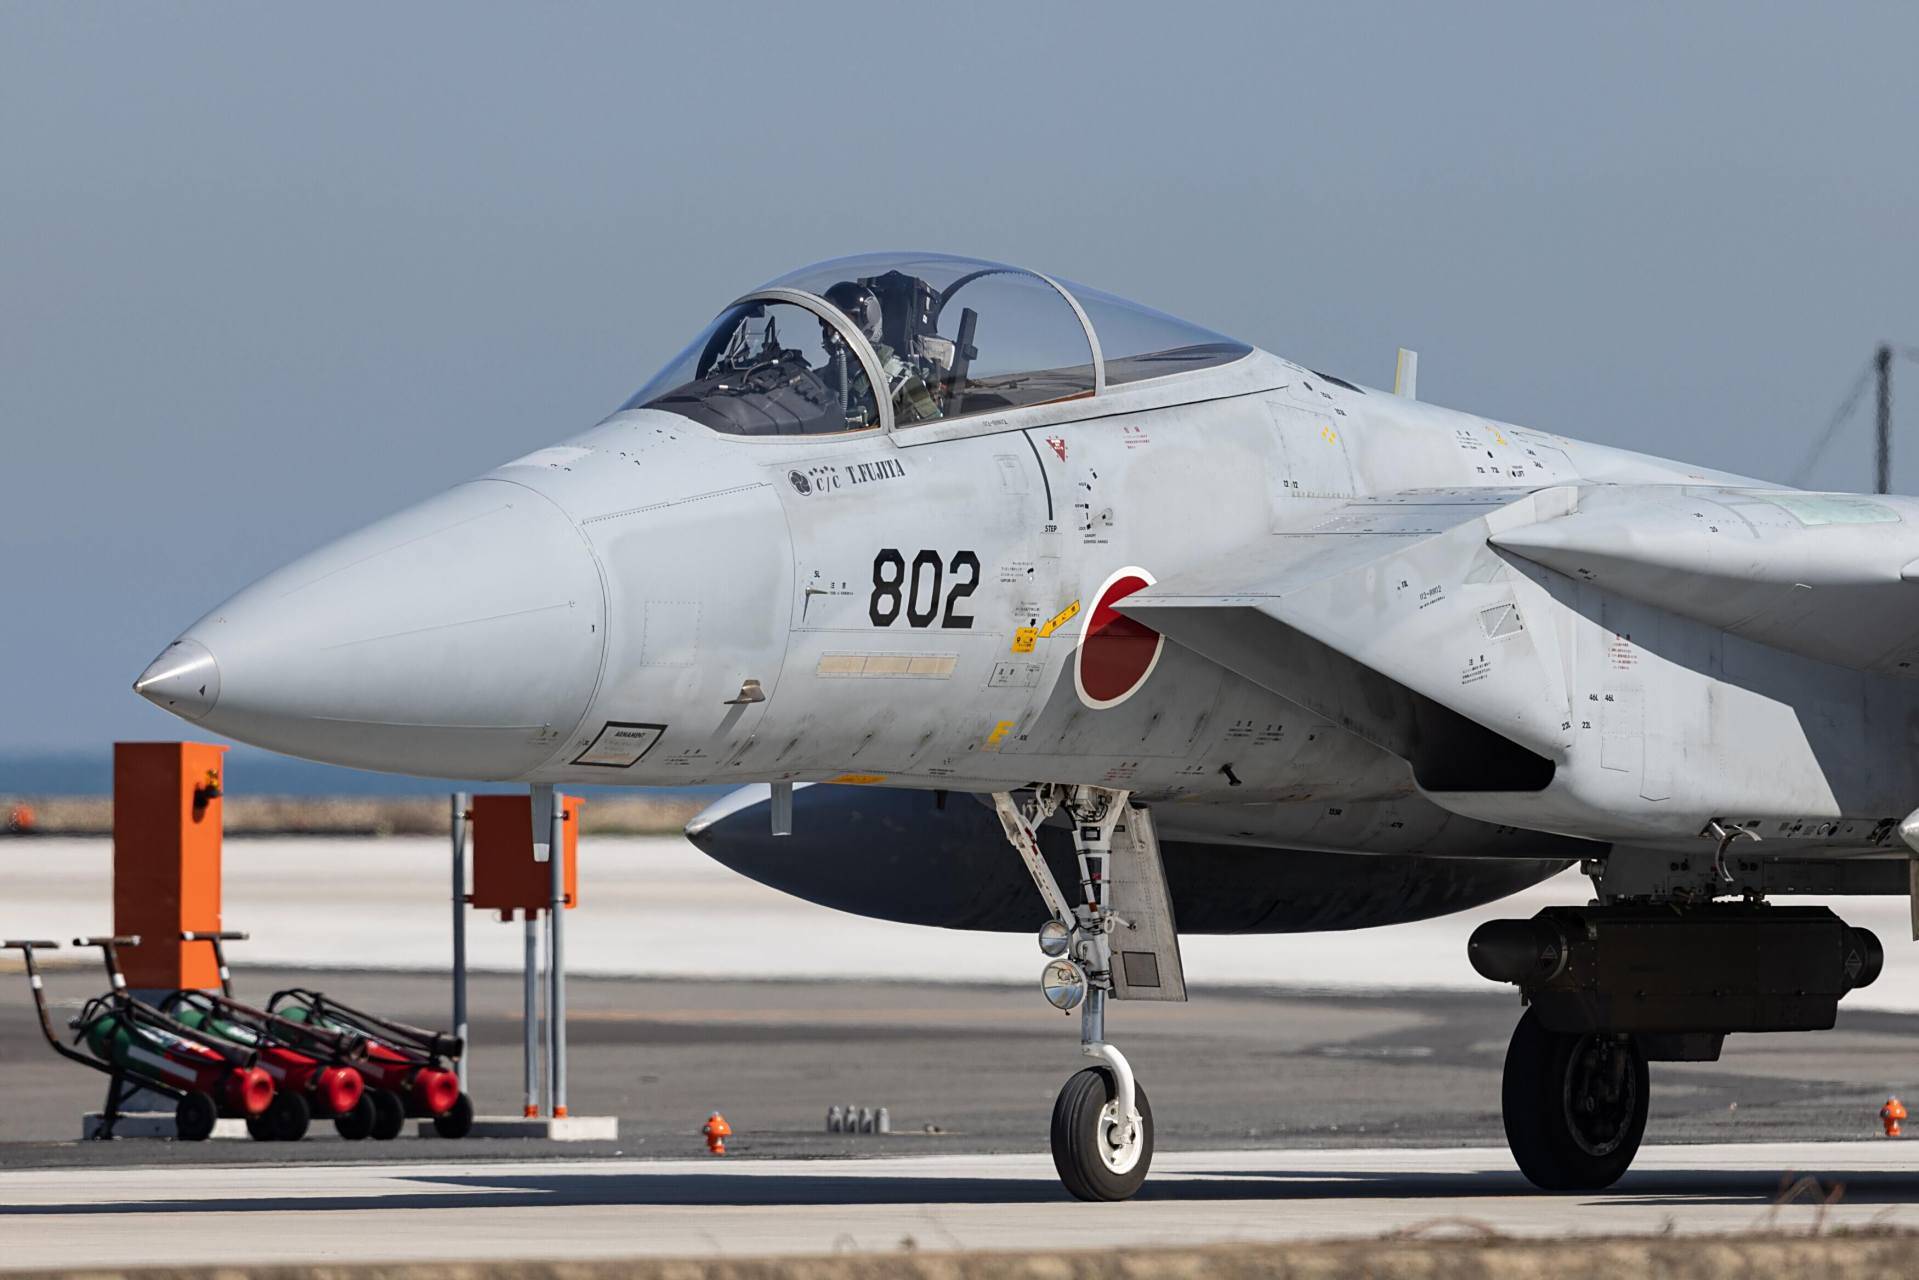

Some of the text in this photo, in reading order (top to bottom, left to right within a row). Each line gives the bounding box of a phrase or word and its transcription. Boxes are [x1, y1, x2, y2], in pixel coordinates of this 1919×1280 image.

[845, 458, 906, 485] T.FUJITA
[1044, 524, 1058, 533] STEP
[868, 548, 981, 629] 802
